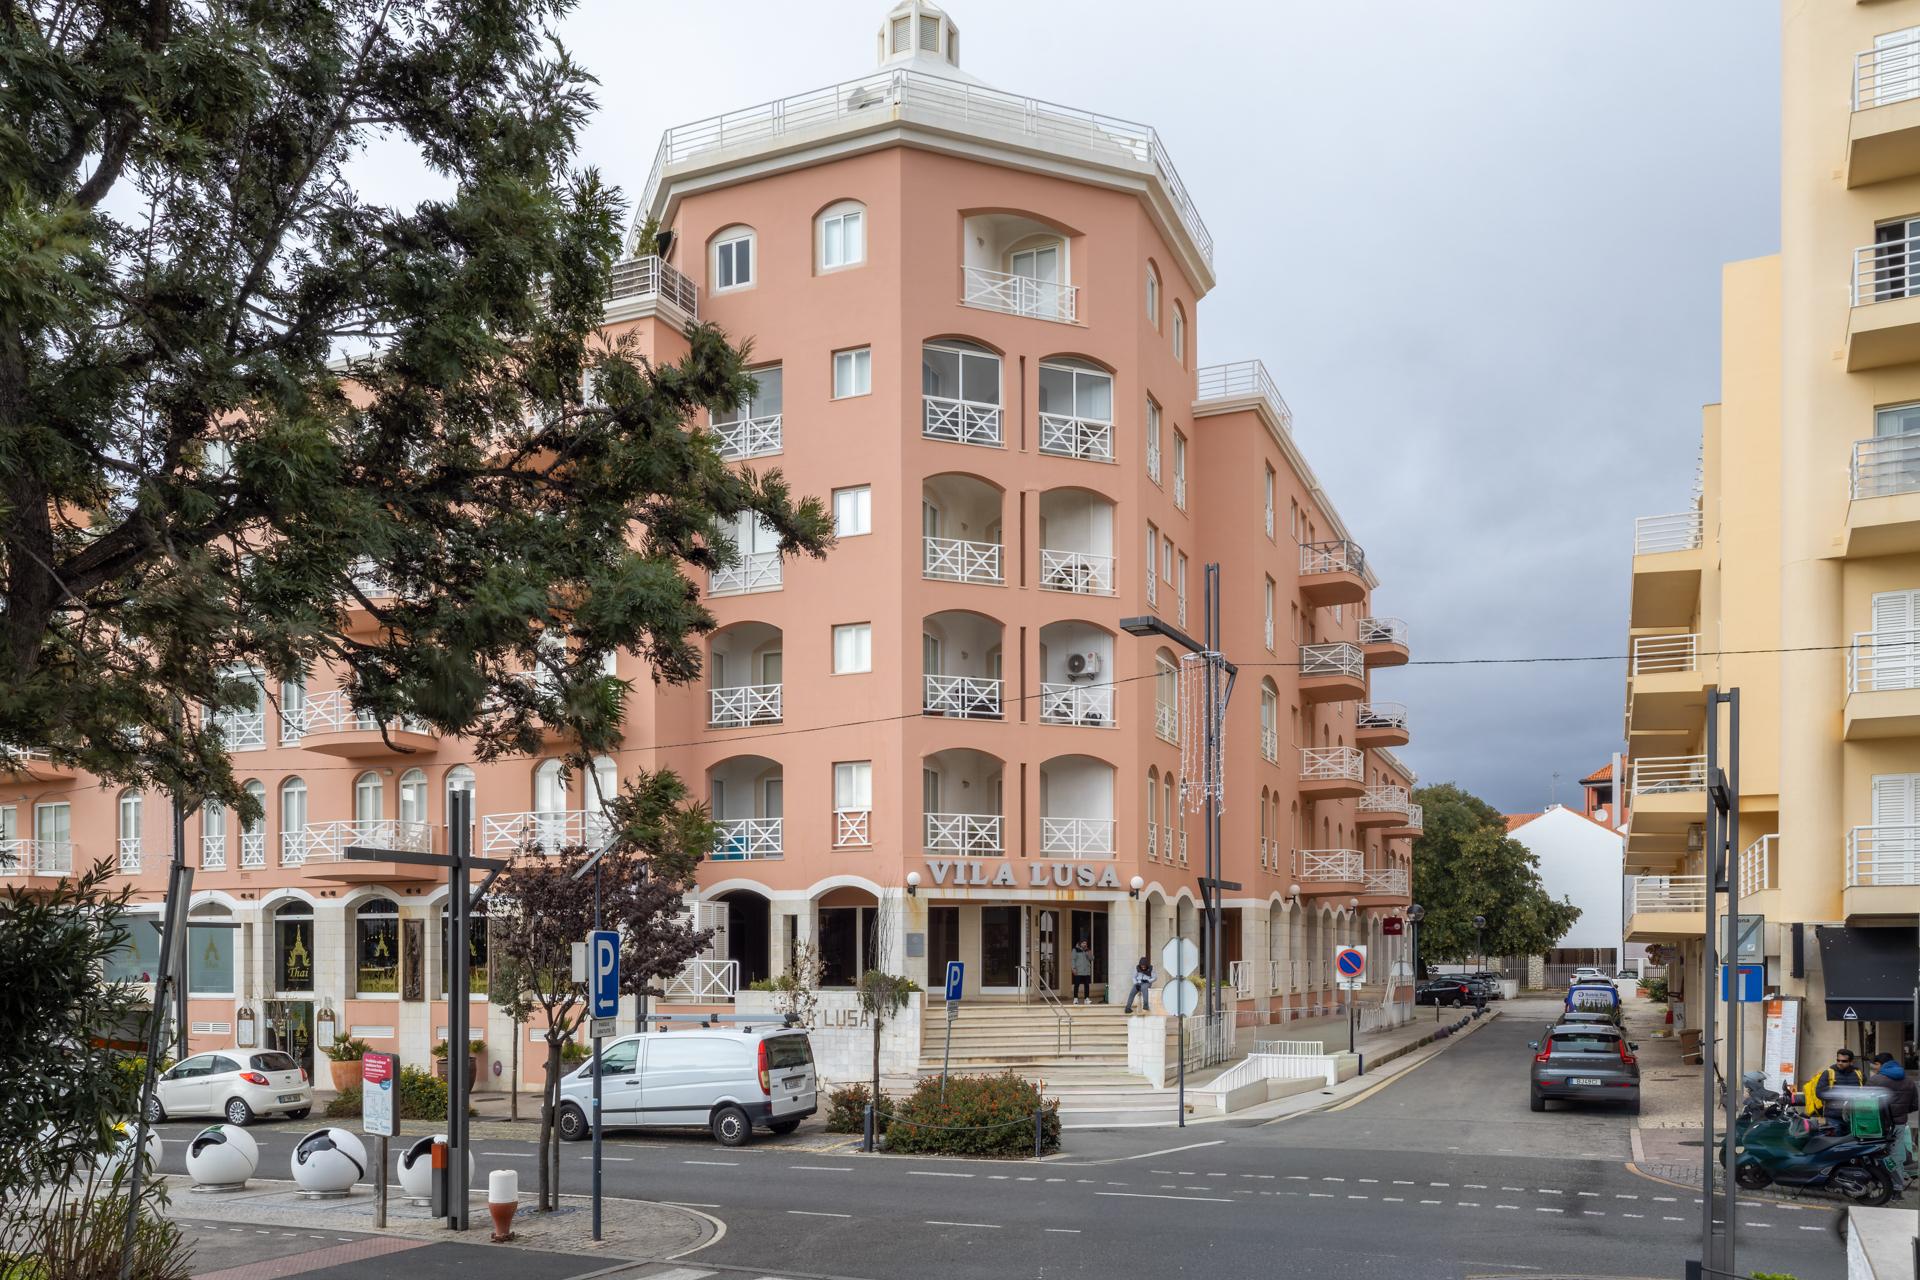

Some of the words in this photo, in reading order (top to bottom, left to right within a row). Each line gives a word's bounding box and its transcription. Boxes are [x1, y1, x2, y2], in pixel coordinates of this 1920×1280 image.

[926, 860, 1018, 886] VILA
[1029, 862, 1122, 888] LUSA
[287, 967, 309, 978] Thai
[598, 940, 614, 994] P
[949, 966, 961, 997] P
[824, 1009, 869, 1027] LUSA
